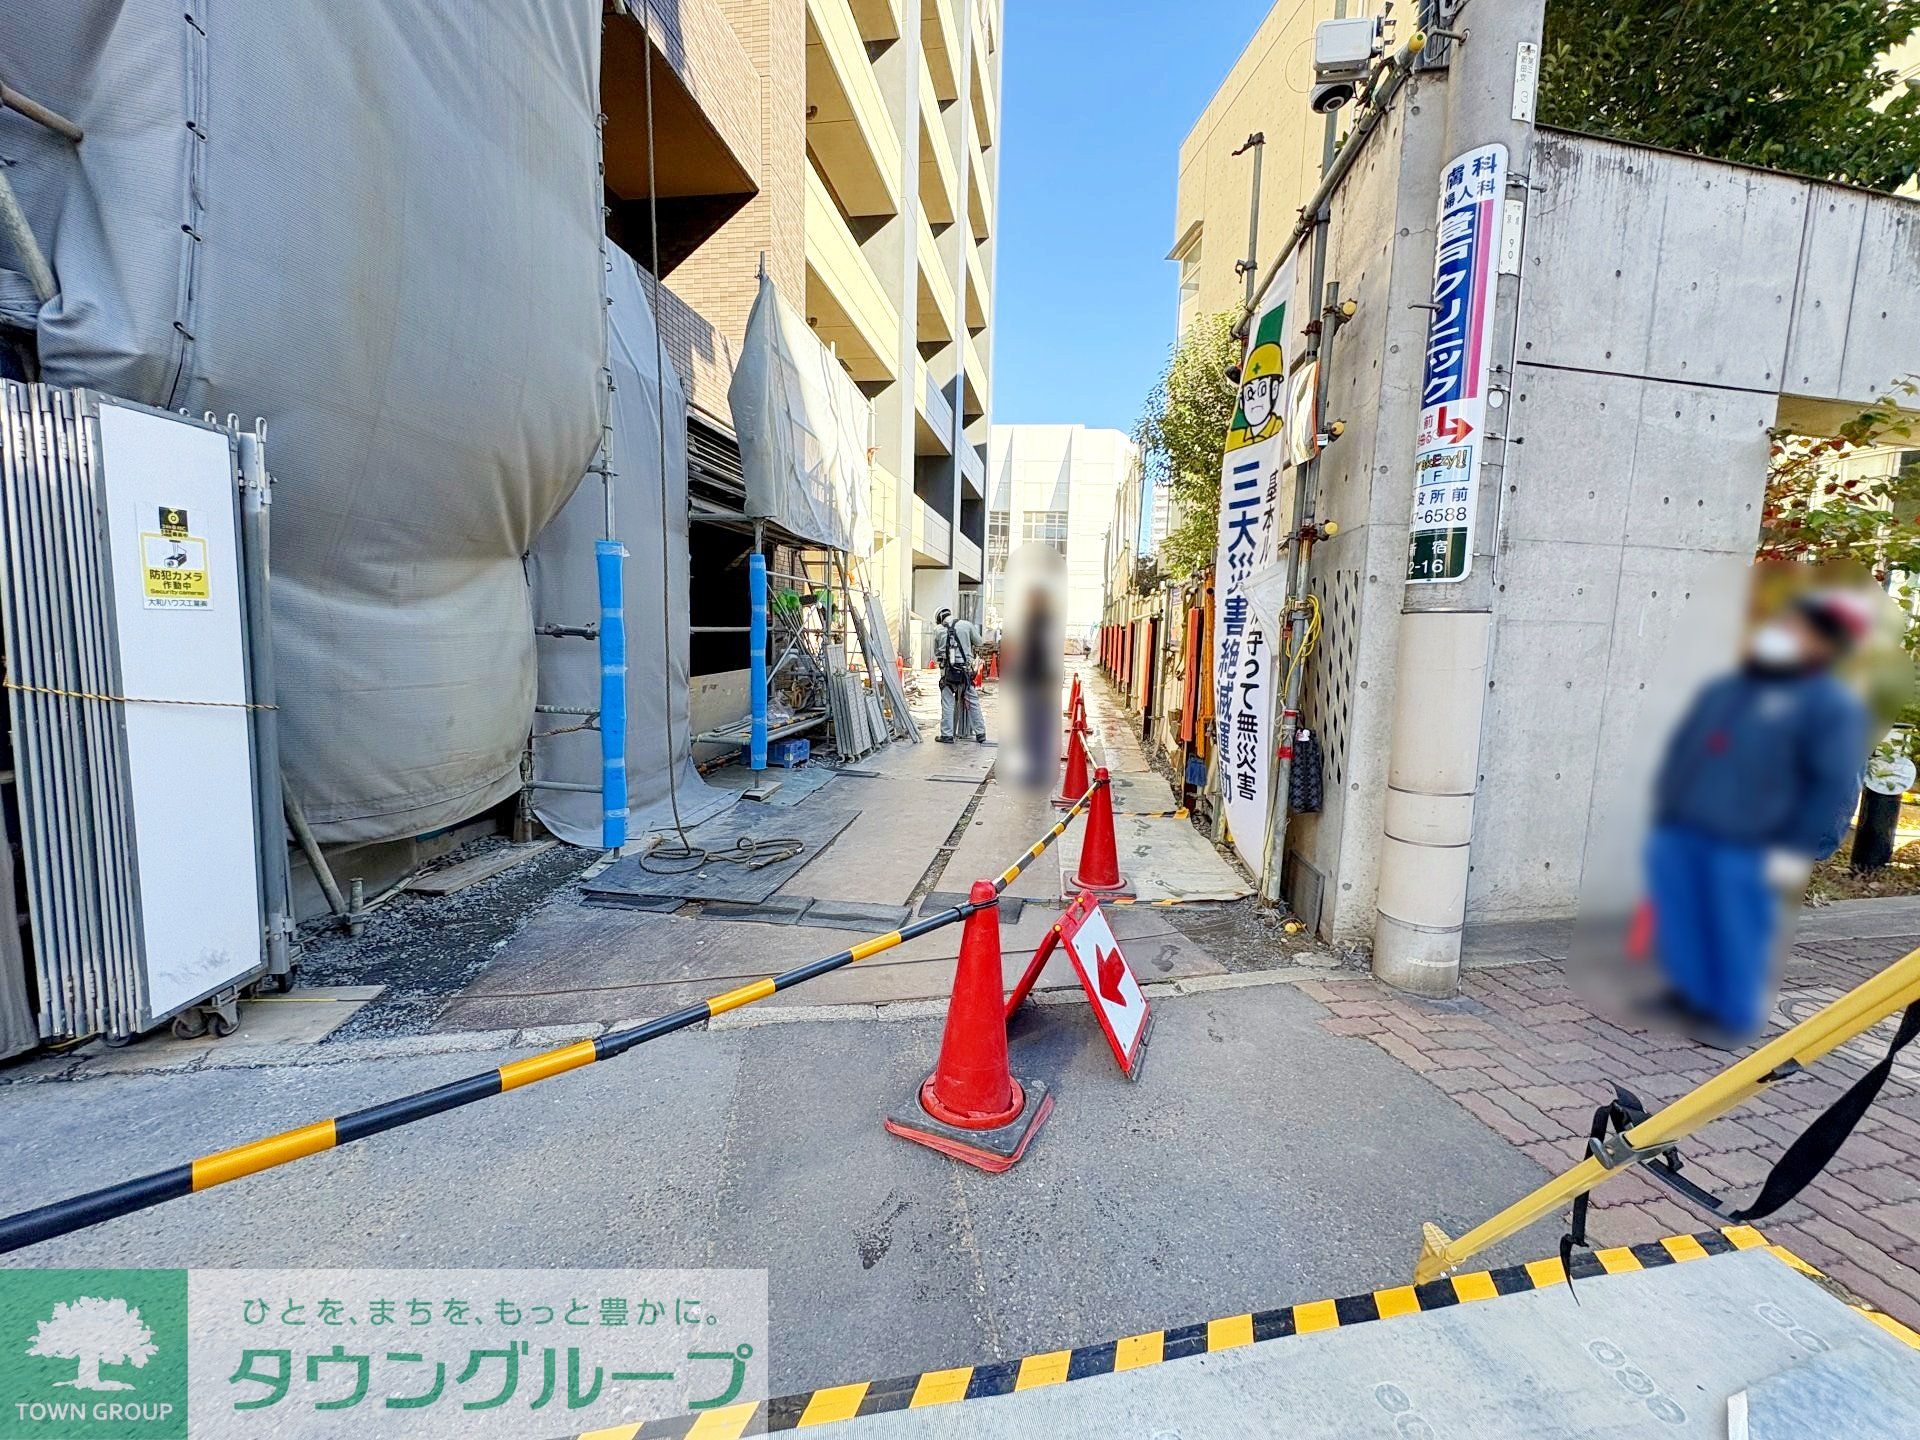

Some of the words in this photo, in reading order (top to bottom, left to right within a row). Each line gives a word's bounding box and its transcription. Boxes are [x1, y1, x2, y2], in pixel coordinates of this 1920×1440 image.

[149, 569, 203, 581] 防犯カメラ
[163, 581, 192, 590] 作動中
[150, 588, 178, 596] Security
